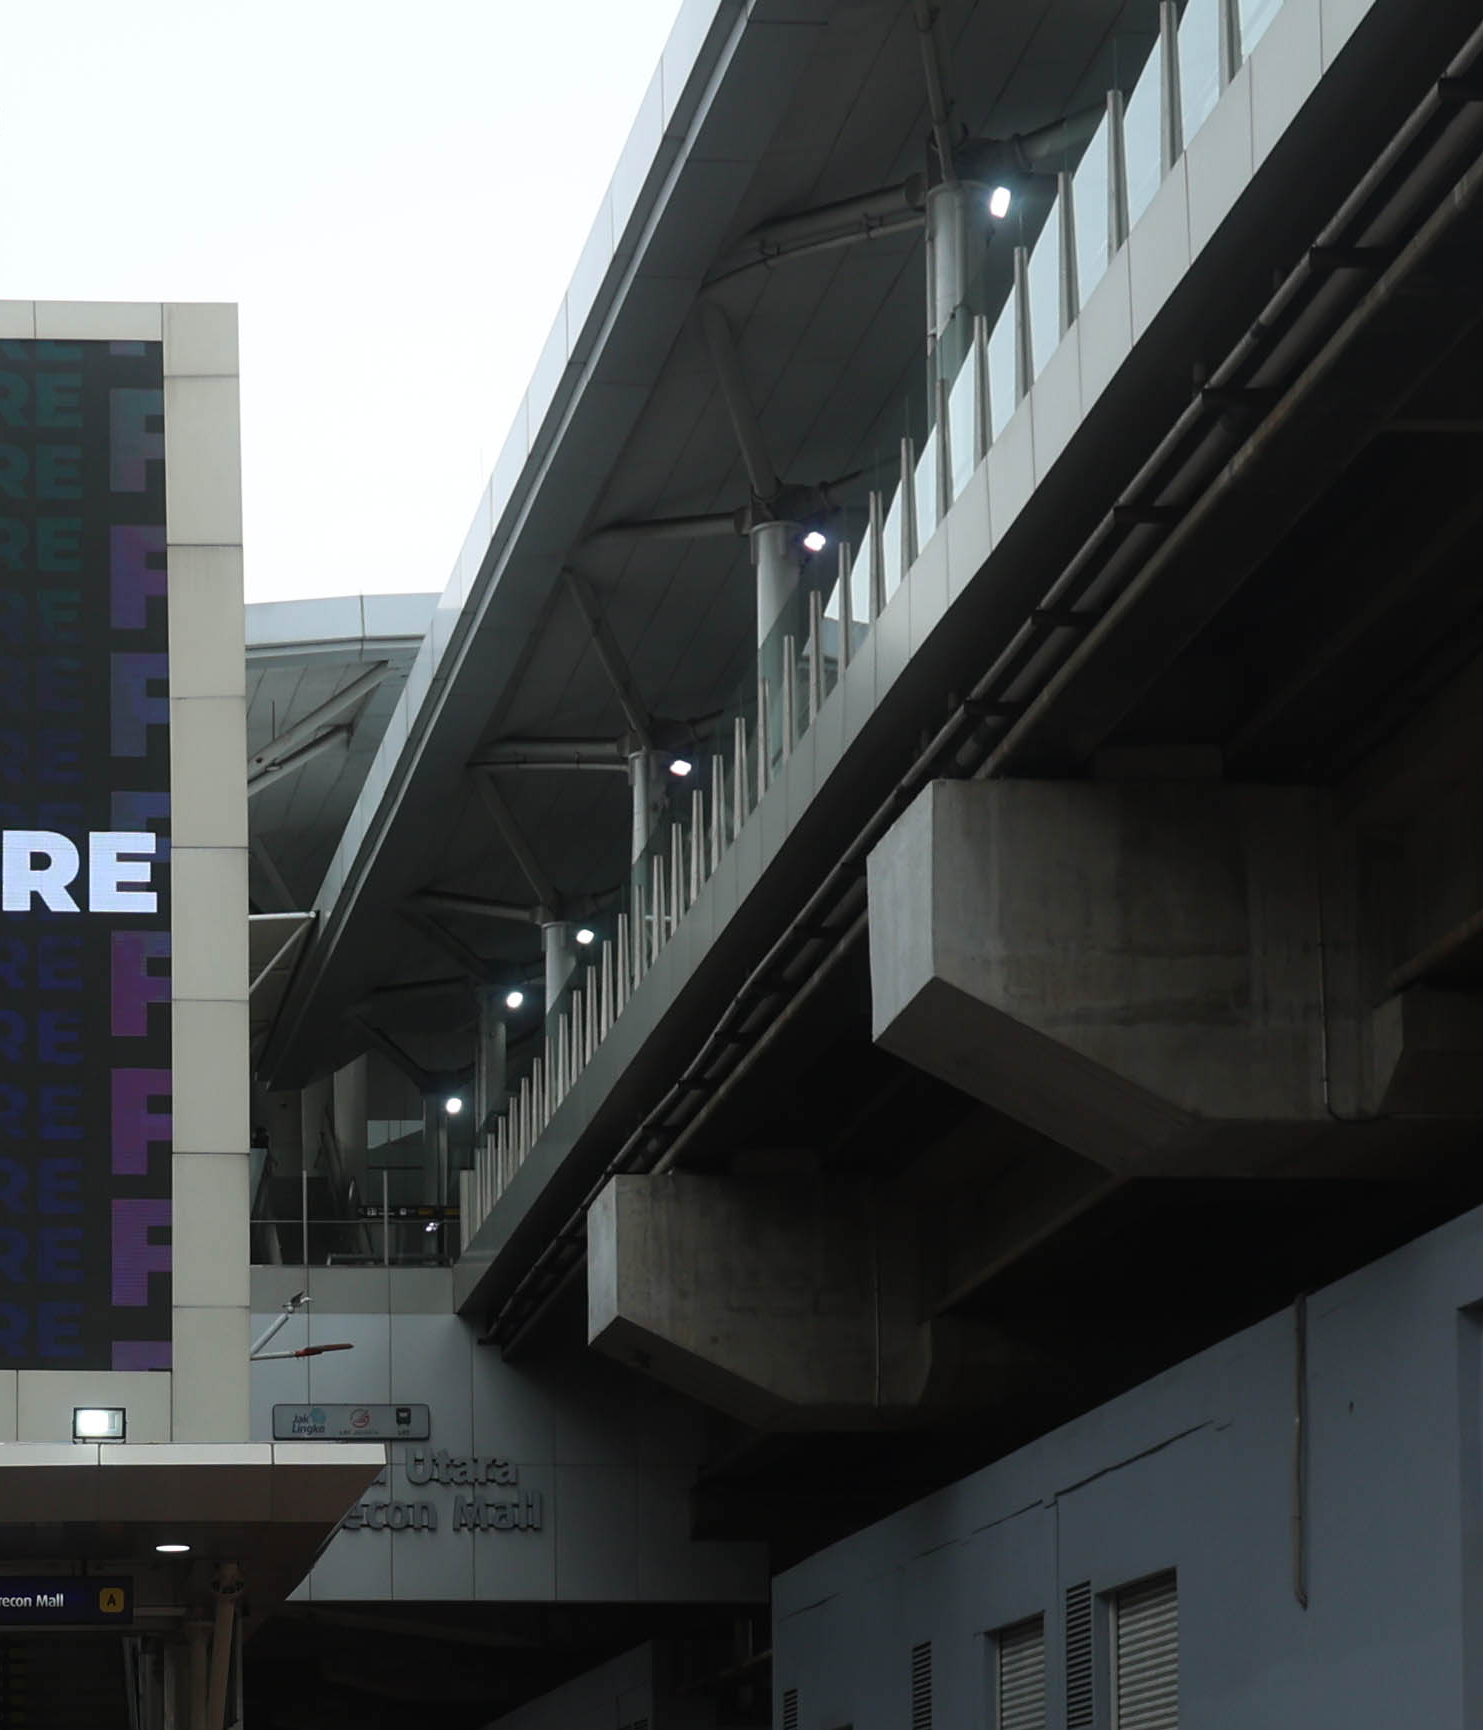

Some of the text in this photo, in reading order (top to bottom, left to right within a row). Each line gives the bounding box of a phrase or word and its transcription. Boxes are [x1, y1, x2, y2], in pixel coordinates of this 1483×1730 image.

[406, 1447, 518, 1487] Utara
[453, 1490, 544, 1532] Mall
[36, 1594, 64, 1608] Mall
[106, 1594, 117, 1607] A
